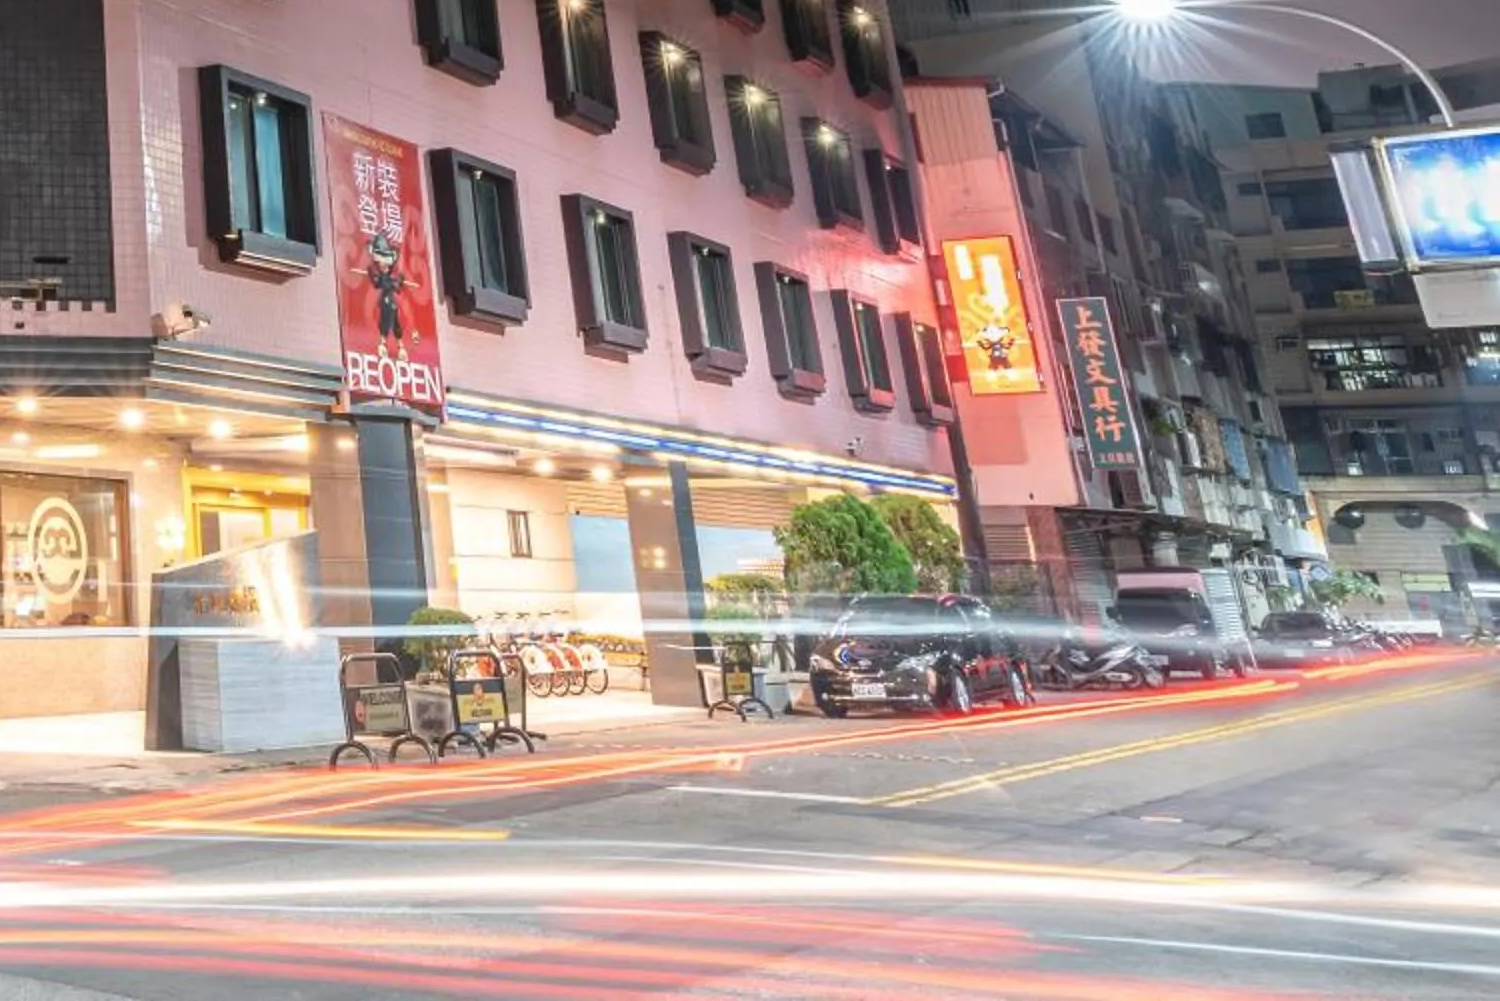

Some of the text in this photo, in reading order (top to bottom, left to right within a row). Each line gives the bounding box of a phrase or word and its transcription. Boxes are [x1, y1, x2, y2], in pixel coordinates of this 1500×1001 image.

[353, 152, 400, 202] 新裝
[357, 194, 403, 243] 登場
[346, 351, 442, 401] REOPEN
